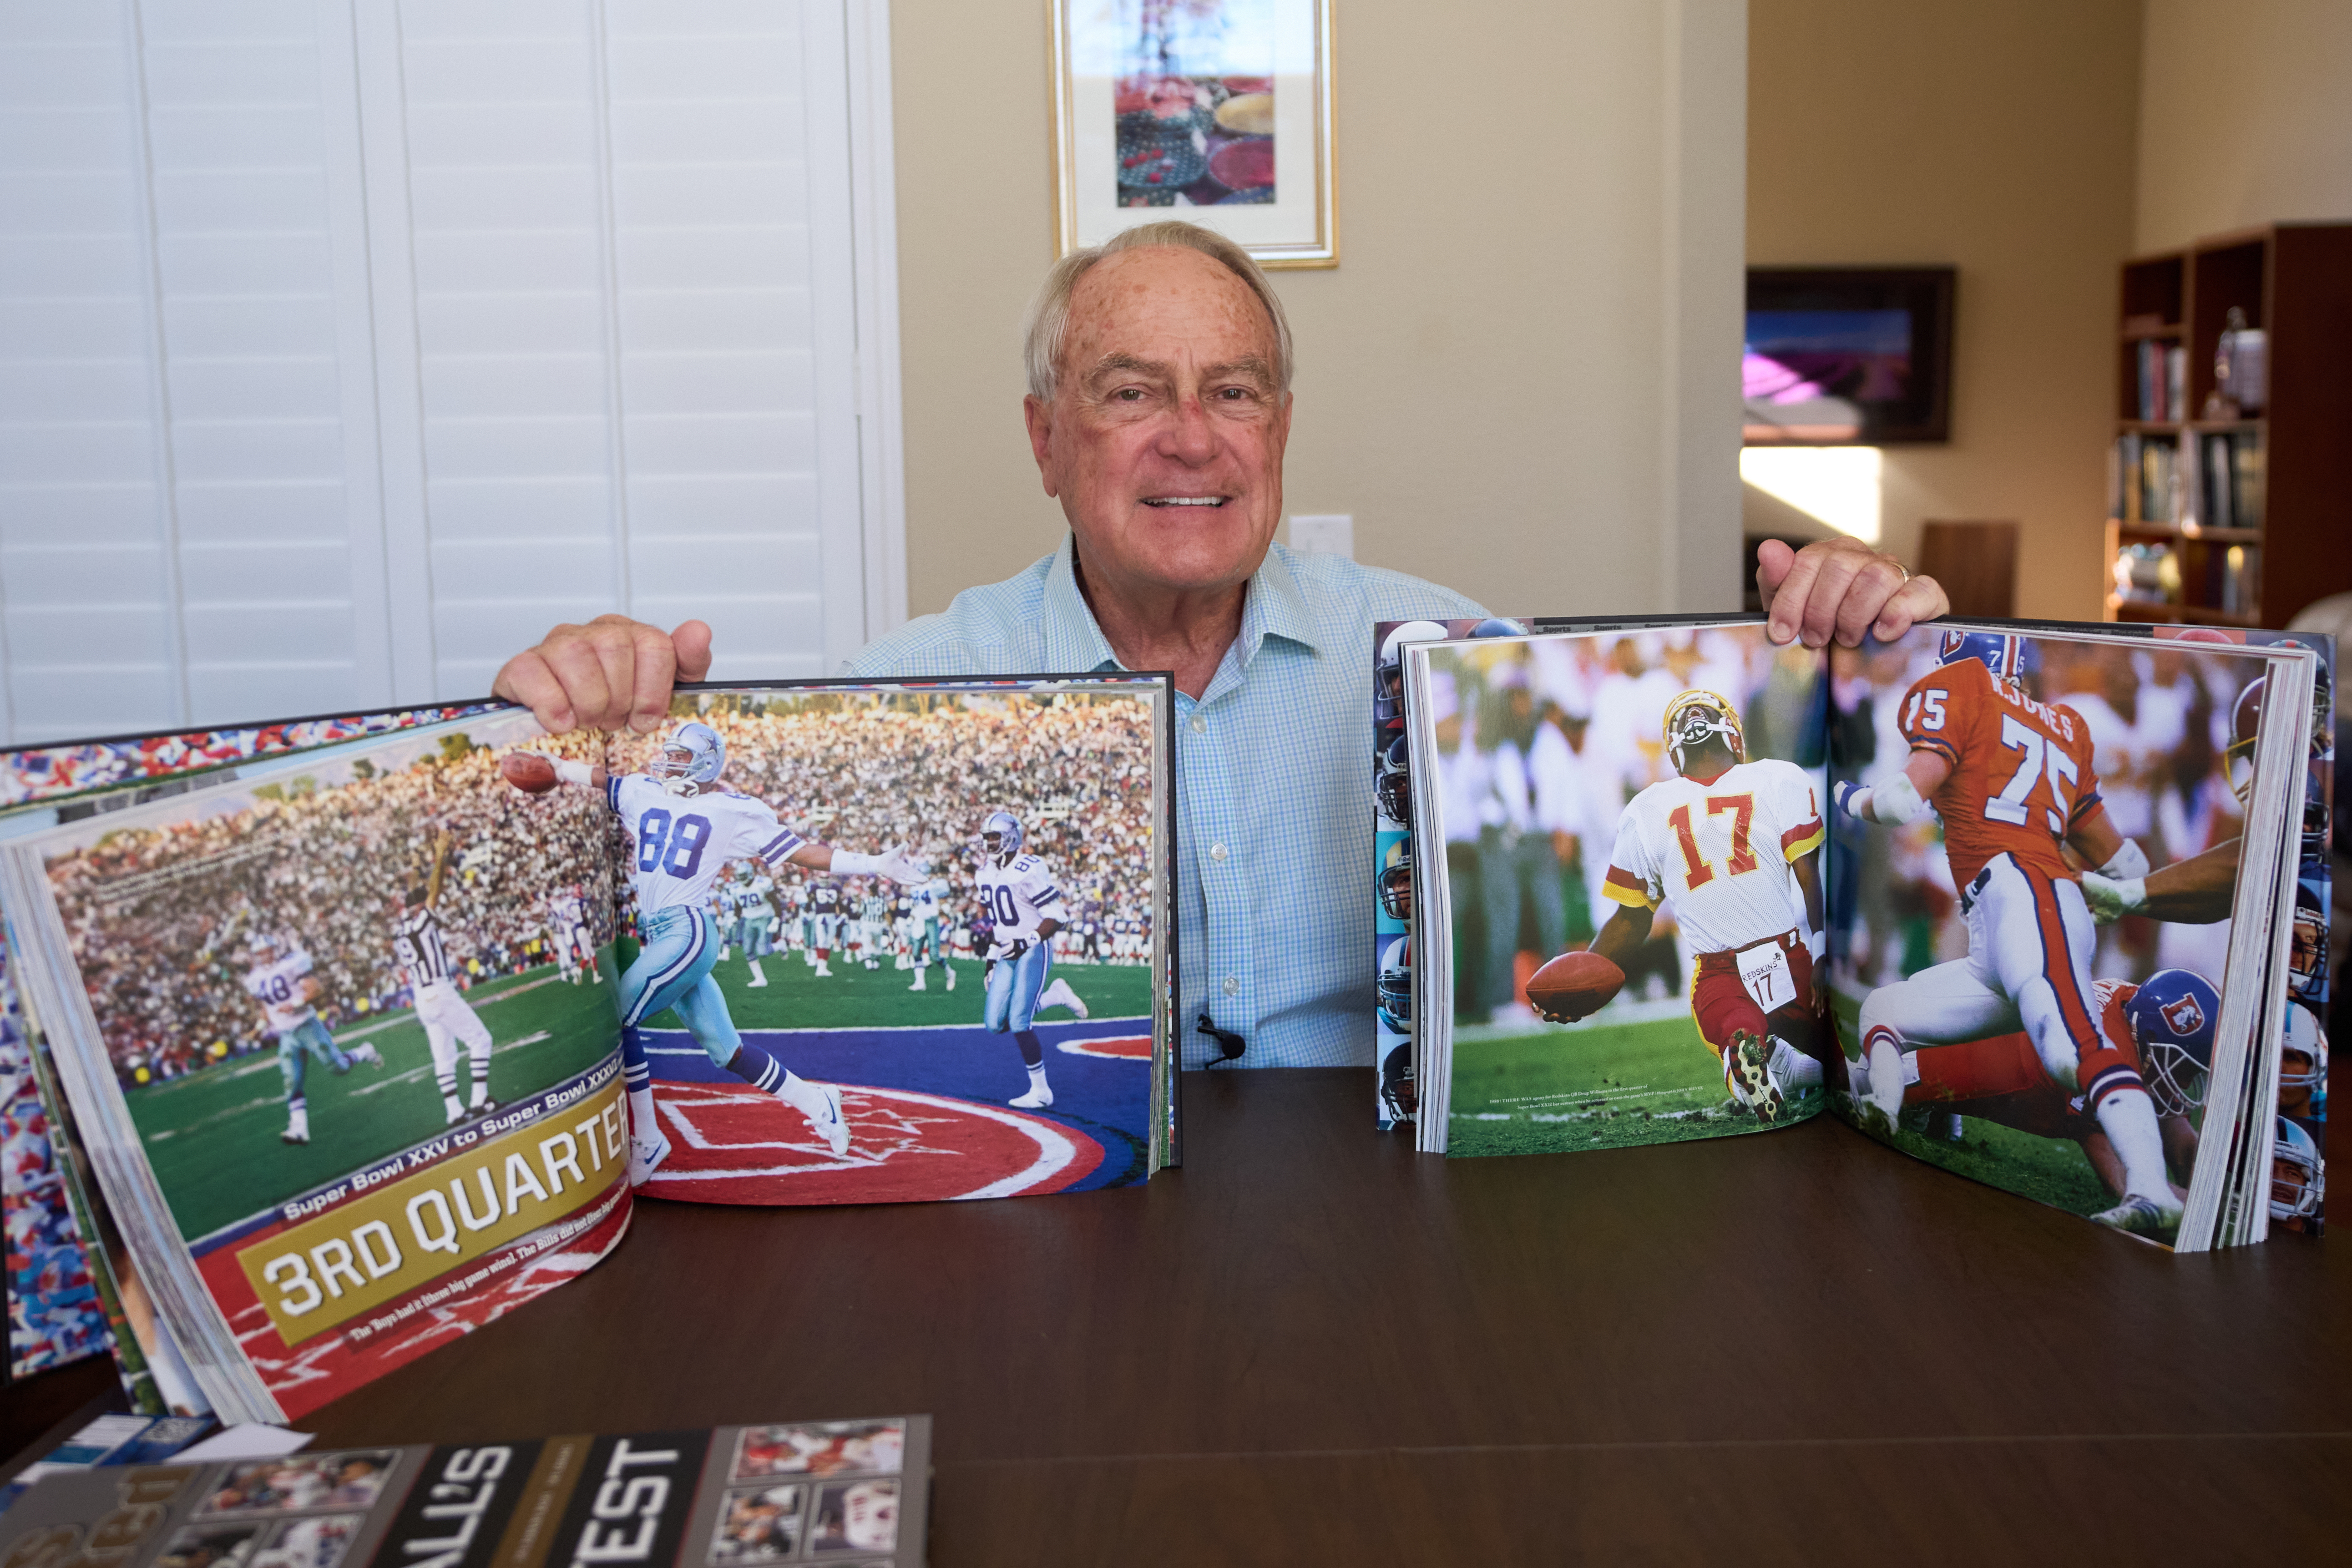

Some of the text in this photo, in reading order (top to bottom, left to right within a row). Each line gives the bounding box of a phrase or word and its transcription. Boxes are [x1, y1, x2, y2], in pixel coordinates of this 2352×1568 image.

[1989, 650, 2001, 667] 7
[1985, 713, 2078, 834] 75
[639, 808, 712, 880] 88
[1668, 791, 1759, 891] 17
[1742, 961, 1778, 982] REDSKINS
[1752, 972, 1773, 1006] 17
[264, 1089, 628, 1316] 3RD QUARTER
[283, 1184, 348, 1220] Super
[351, 1158, 405, 1191] Bowl
[408, 1138, 449, 1168] XXV
[453, 1130, 478, 1147] to
[481, 1102, 541, 1136] Super
[546, 1080, 587, 1109] Bowl
[349, 1325, 373, 1340] The
[394, 1302, 416, 1320] had
[412, 1299, 424, 1310] it
[447, 1280, 467, 1294] big
[464, 1268, 491, 1288] game
[516, 1244, 537, 1259] The
[536, 1233, 560, 1251] Bills
[559, 1226, 574, 1239] did
[573, 1219, 587, 1229] not
[395, 1447, 512, 1568] LL'S
[570, 1439, 679, 1568] EST
